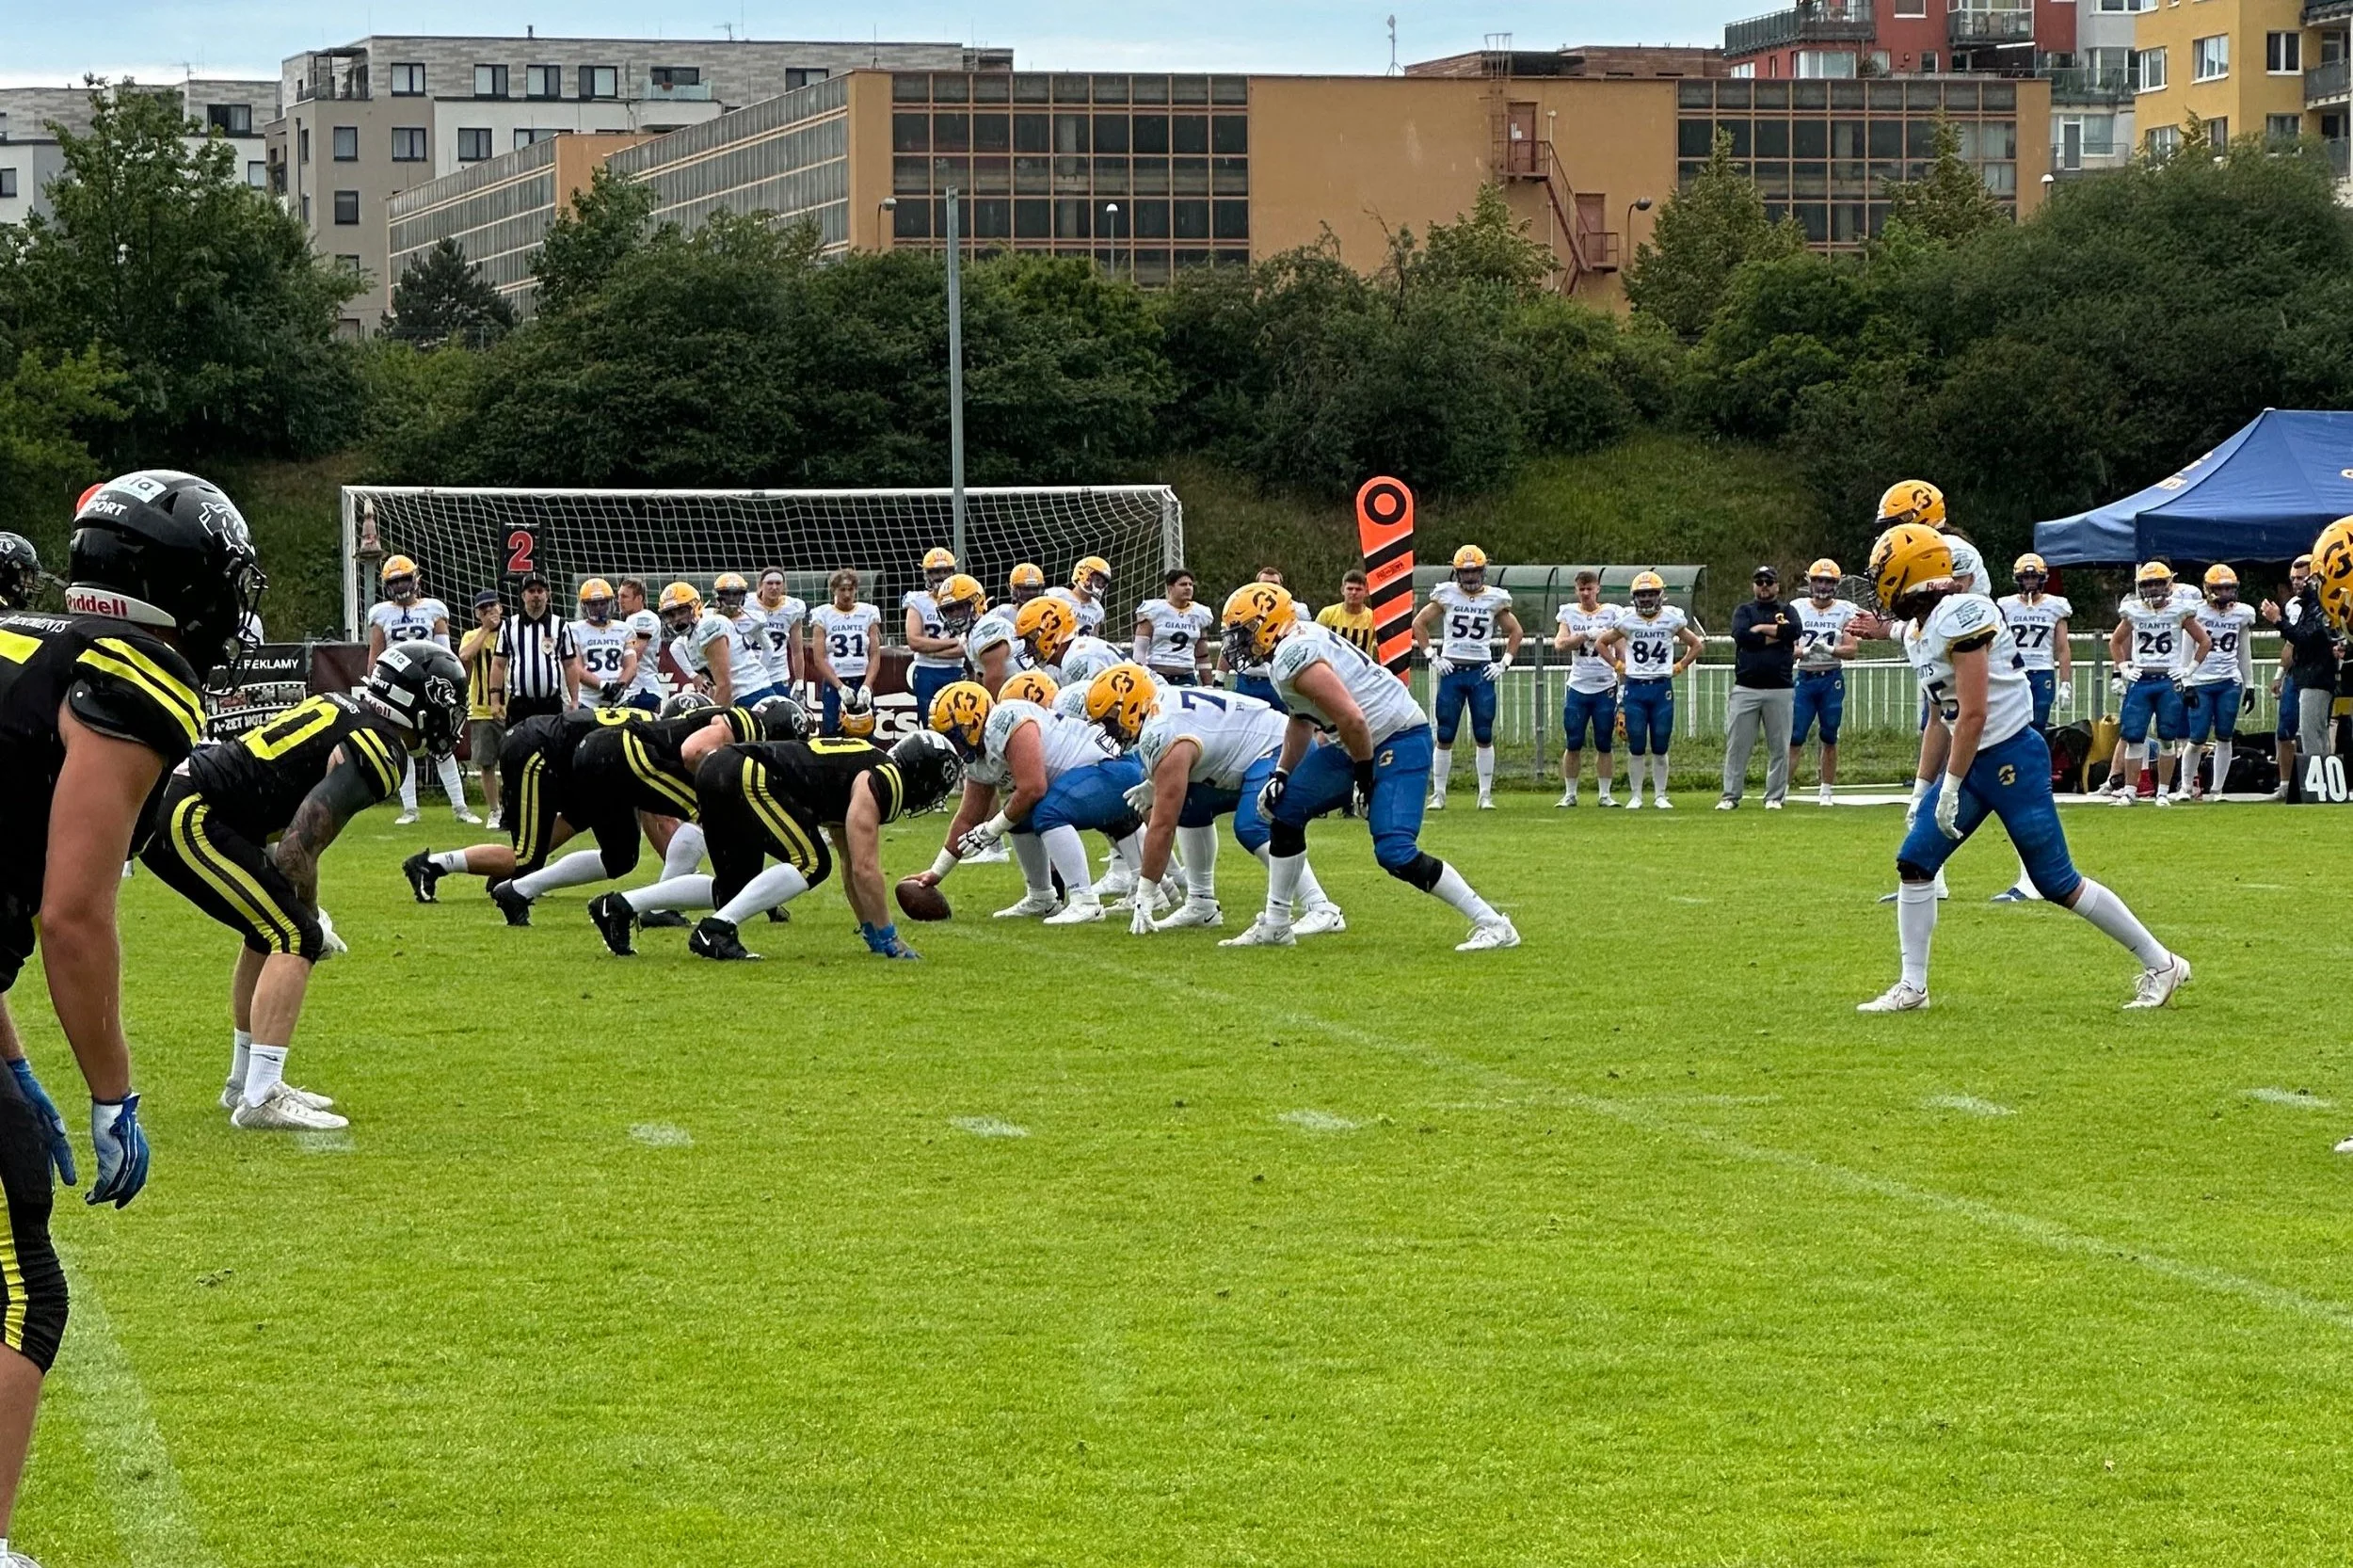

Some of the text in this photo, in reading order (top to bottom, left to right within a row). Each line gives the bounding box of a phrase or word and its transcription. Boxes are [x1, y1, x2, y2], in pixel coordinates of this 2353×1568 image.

[508, 530, 534, 571] 2
[1454, 605, 1487, 615] GIANTS
[831, 624, 863, 632] GIANTS
[1164, 621, 1196, 632] GIANTS
[1451, 615, 1489, 640] 55
[1635, 631, 1666, 639] GIANTS
[1804, 620, 1837, 629] GIANTS
[2138, 621, 2171, 630] GIANTS
[2204, 620, 2237, 630] GIANTS
[830, 633, 865, 658] 31
[1169, 631, 1190, 652] 9
[2011, 624, 2050, 648] 27
[2137, 631, 2173, 655] 26
[586, 648, 622, 672] 58
[1632, 640, 1669, 664] 84
[2305, 755, 2347, 802] 40
